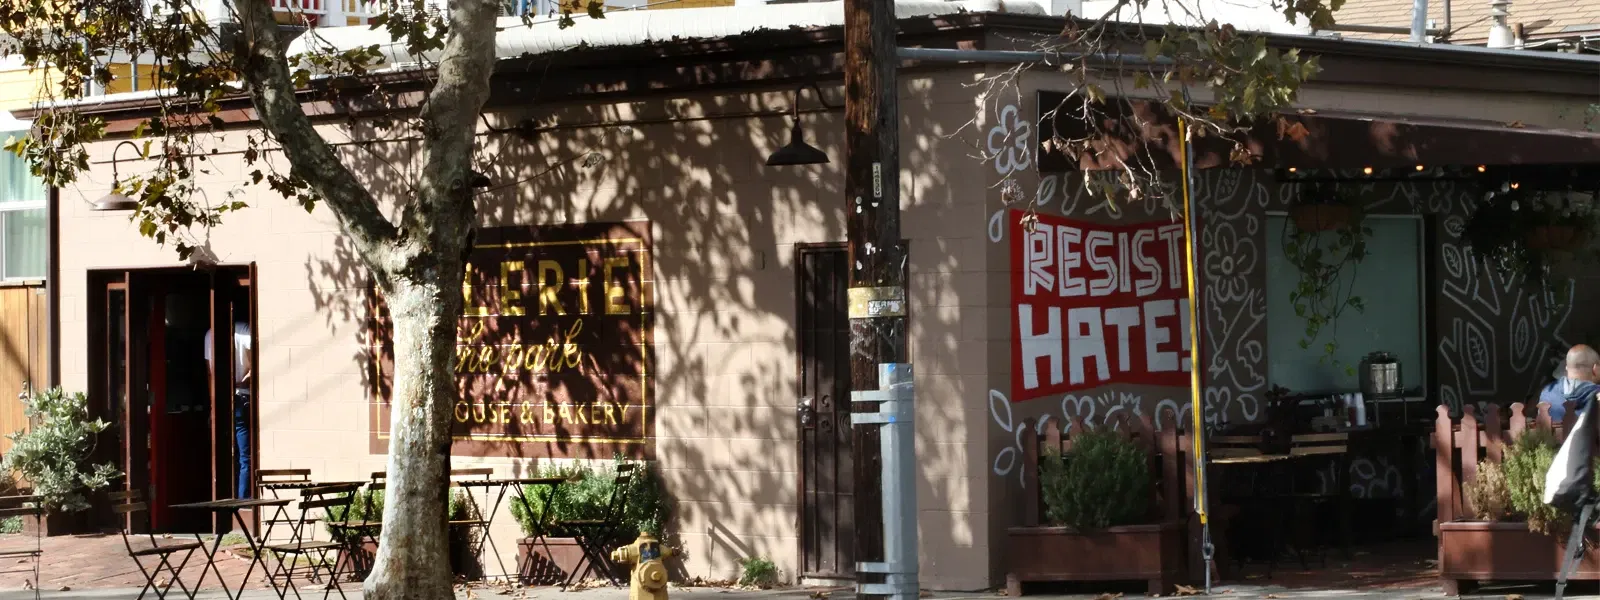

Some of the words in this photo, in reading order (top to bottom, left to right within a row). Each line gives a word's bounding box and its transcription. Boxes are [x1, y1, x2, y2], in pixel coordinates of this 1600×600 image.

[463, 256, 631, 317] LERIE
[1023, 223, 1184, 297] RESIST
[494, 319, 583, 392] park
[1018, 298, 1193, 390] HATE!
[455, 400, 512, 425] OUSE
[520, 401, 534, 425] &
[543, 401, 630, 425] BAKERY
